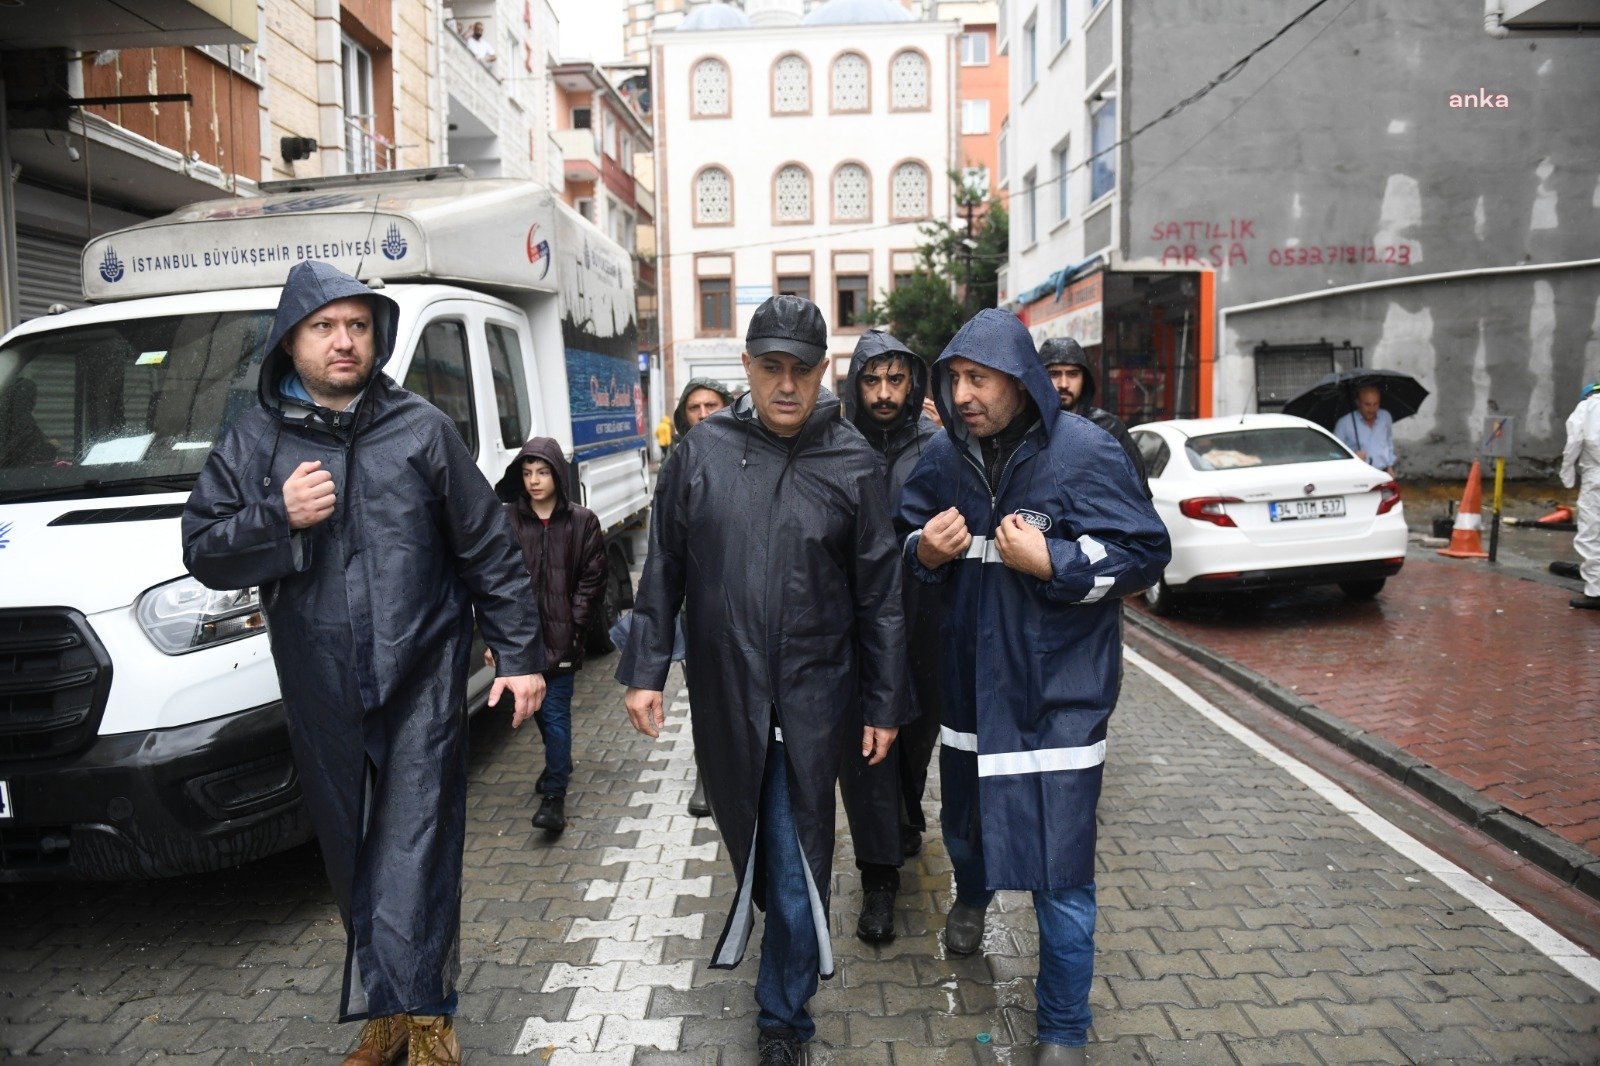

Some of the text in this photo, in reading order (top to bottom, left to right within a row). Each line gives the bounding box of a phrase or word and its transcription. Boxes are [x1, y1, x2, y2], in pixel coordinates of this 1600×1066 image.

[1150, 218, 1256, 241] SATILIK
[132, 237, 377, 273] İSTANBUL BÜYÜKŞEHİR BELEDİYESİ
[1161, 241, 1248, 268] ARSA
[1278, 504, 1291, 516] 34
[1322, 499, 1341, 512] 637
